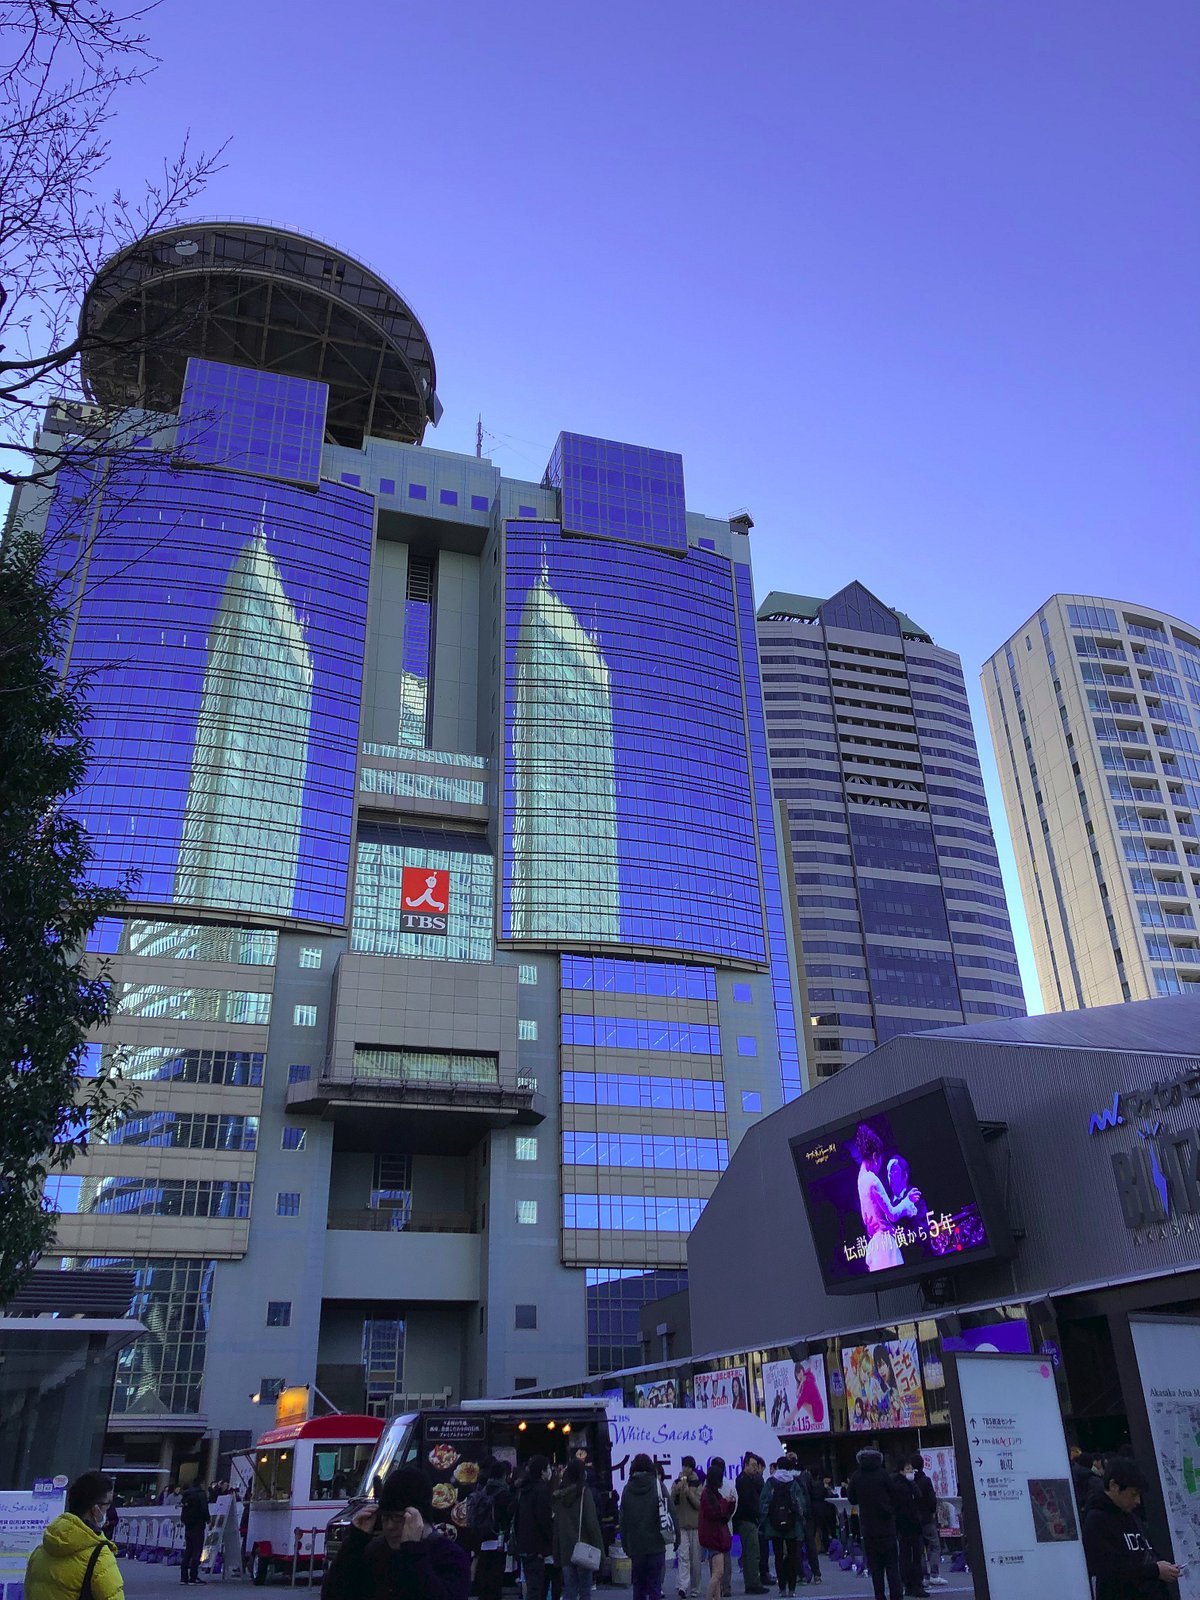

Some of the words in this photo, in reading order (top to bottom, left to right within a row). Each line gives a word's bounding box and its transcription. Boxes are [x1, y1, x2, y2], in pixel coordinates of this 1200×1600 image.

[402, 914, 446, 930] TBS
[1151, 1386, 1176, 1397] Akasaka
[1178, 1388, 1192, 1397] Area
[610, 1423, 651, 1445] White
[652, 1424, 697, 1444] Sacas
